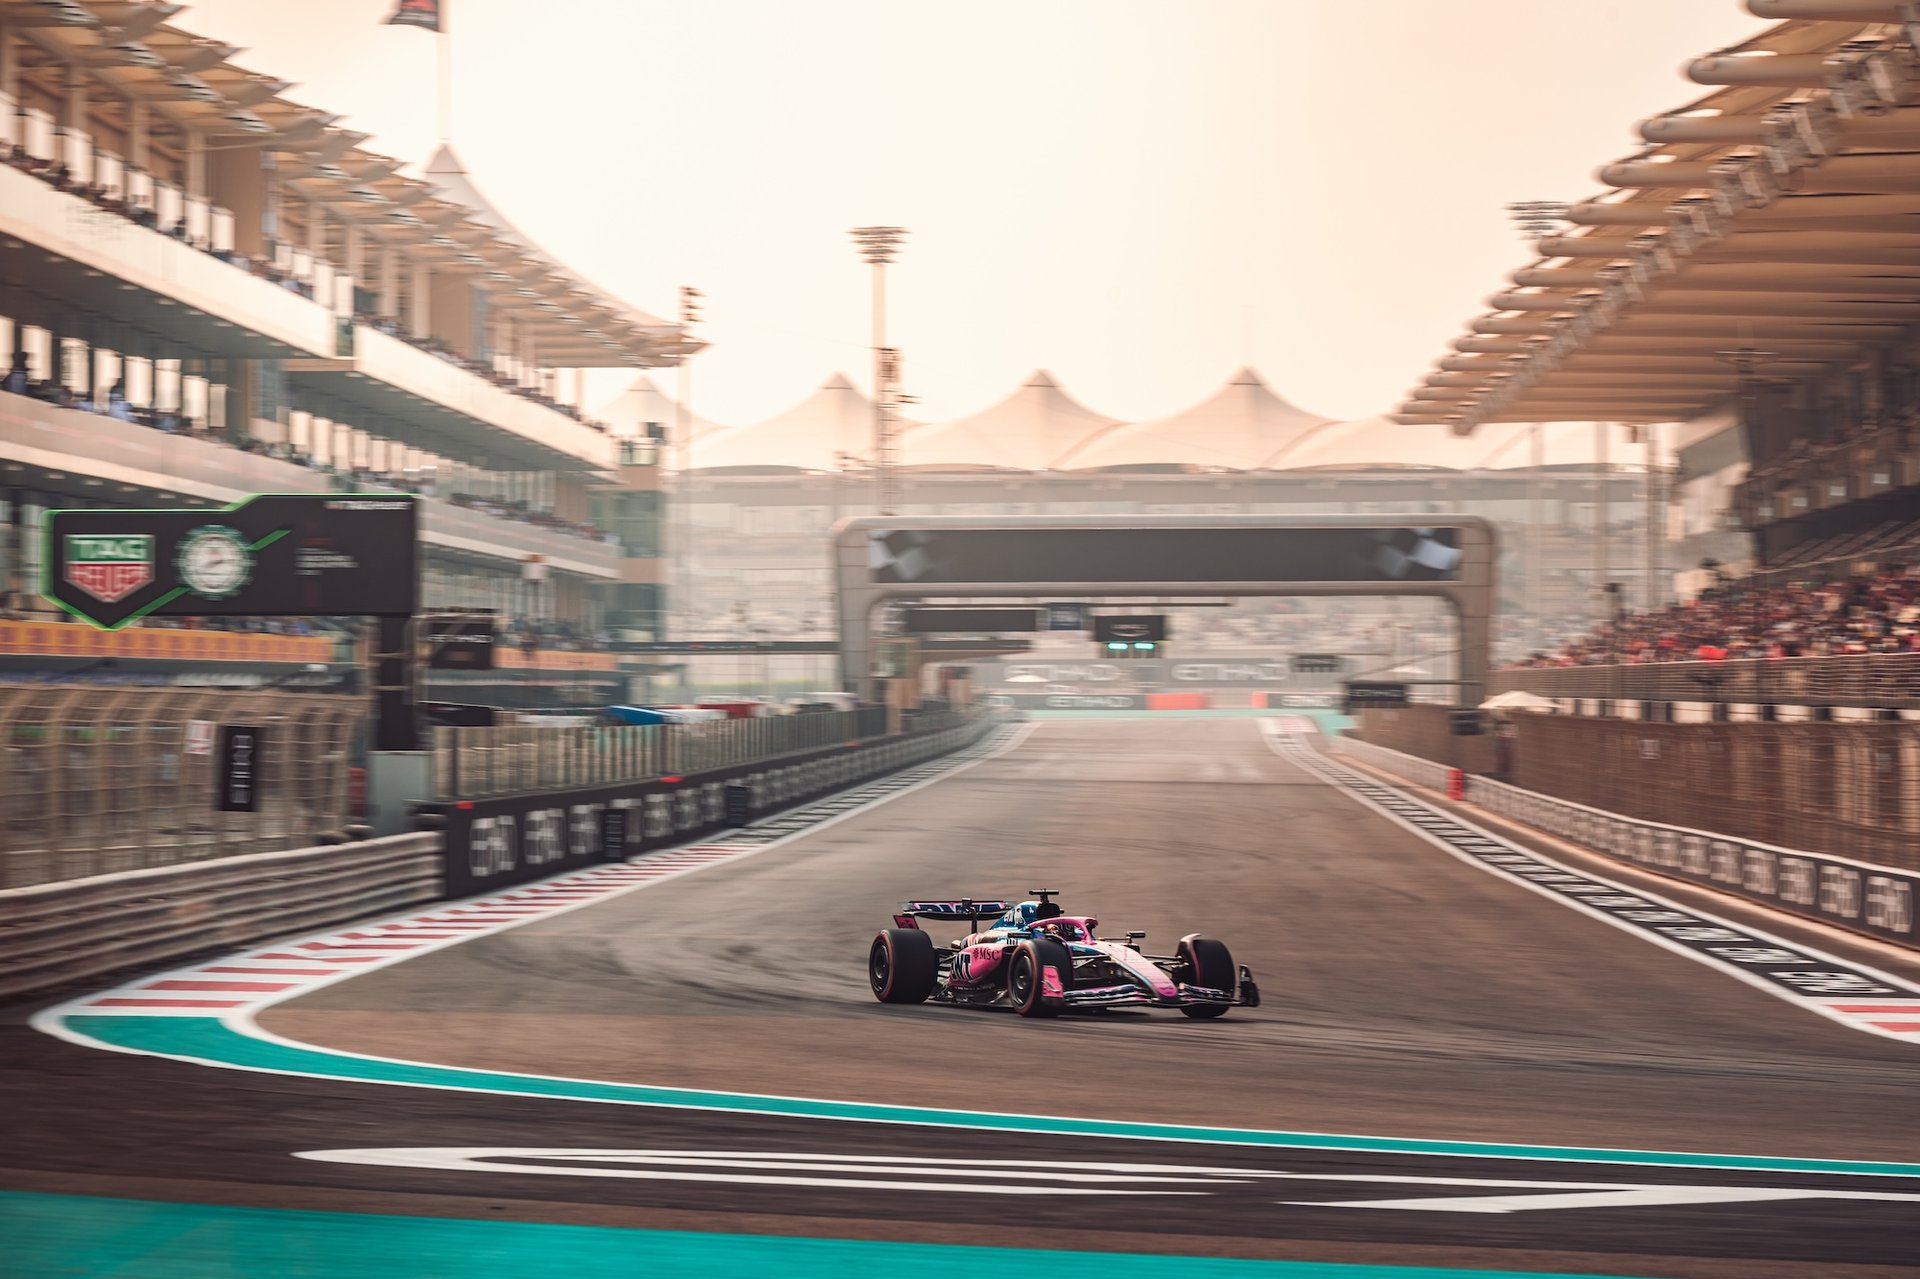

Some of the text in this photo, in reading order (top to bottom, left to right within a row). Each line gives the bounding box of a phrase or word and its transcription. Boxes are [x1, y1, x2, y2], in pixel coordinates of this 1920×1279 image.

[71, 539, 148, 559] TAG
[69, 565, 151, 598] HEUER
[980, 947, 1000, 961] MSC
